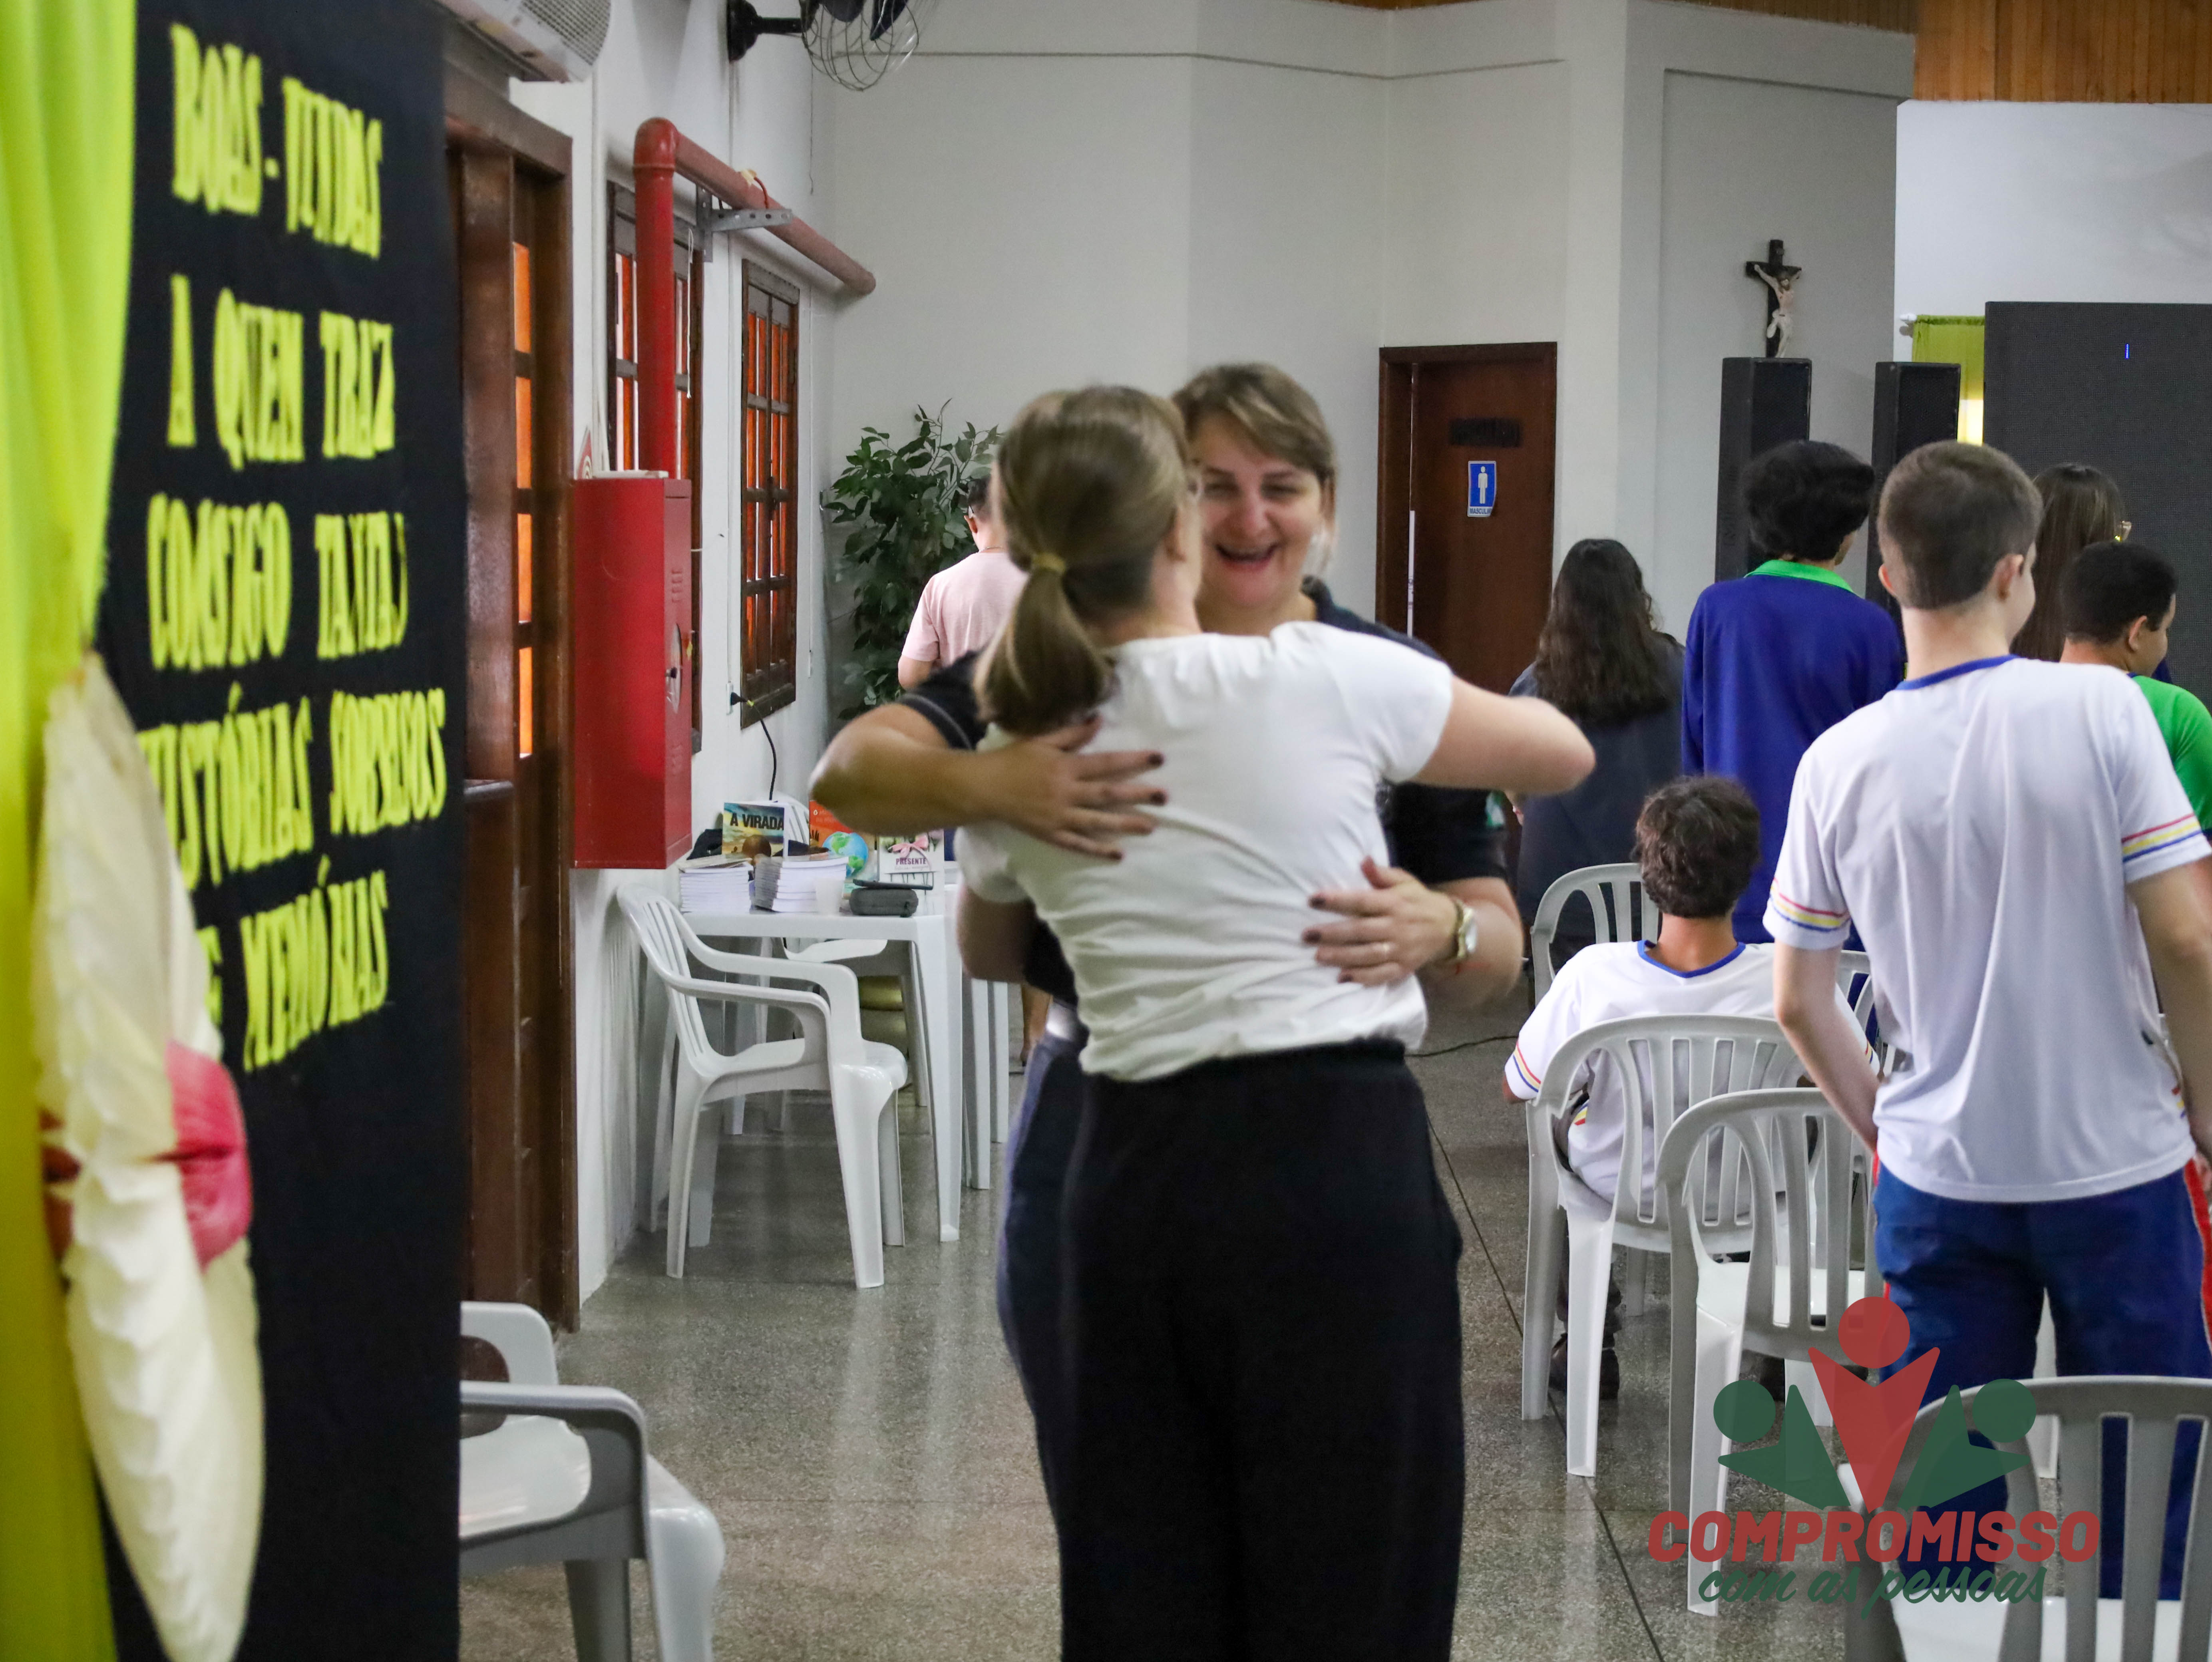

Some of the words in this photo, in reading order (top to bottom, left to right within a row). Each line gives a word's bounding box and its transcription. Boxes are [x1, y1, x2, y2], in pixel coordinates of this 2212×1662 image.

[167, 273, 197, 448] A
[212, 287, 305, 471] QUEM
[318, 310, 396, 461] TRAZ
[146, 493, 292, 672] CONSIGO
[730, 813, 738, 826] A
[742, 814, 784, 831] VIRADA
[239, 854, 389, 1072] MEMÓRIAS
